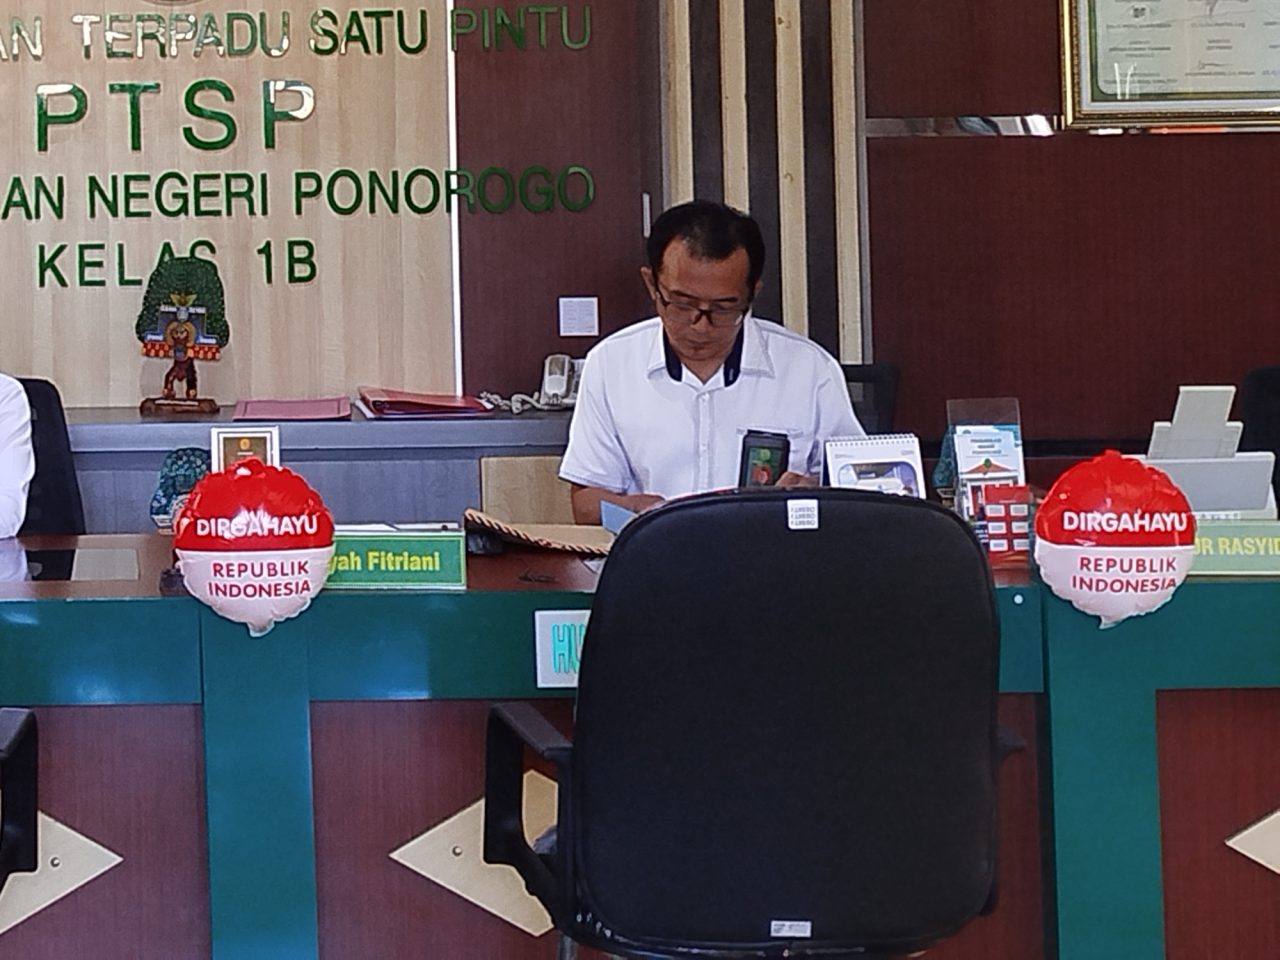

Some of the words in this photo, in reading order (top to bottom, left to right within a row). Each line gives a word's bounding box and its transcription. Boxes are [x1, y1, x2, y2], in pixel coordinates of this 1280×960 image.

[72, 12, 290, 60] TERPADU
[309, 9, 428, 56] SATU
[451, 4, 592, 52] PINTU
[35, 79, 316, 152] PTSP
[88, 172, 269, 220] NEGERI
[294, 165, 595, 216] PONOROGO
[257, 240, 317, 285] 1B
[196, 514, 318, 540] DIRGAHAYU
[1062, 510, 1188, 533] DIRGAHAYU
[212, 560, 310, 579] REPUBLIK
[367, 551, 441, 572] Fitriani
[1079, 555, 1178, 574] REPUBLIK
[207, 580, 312, 598] INDONESIA
[1071, 575, 1178, 593] INDONESIA
